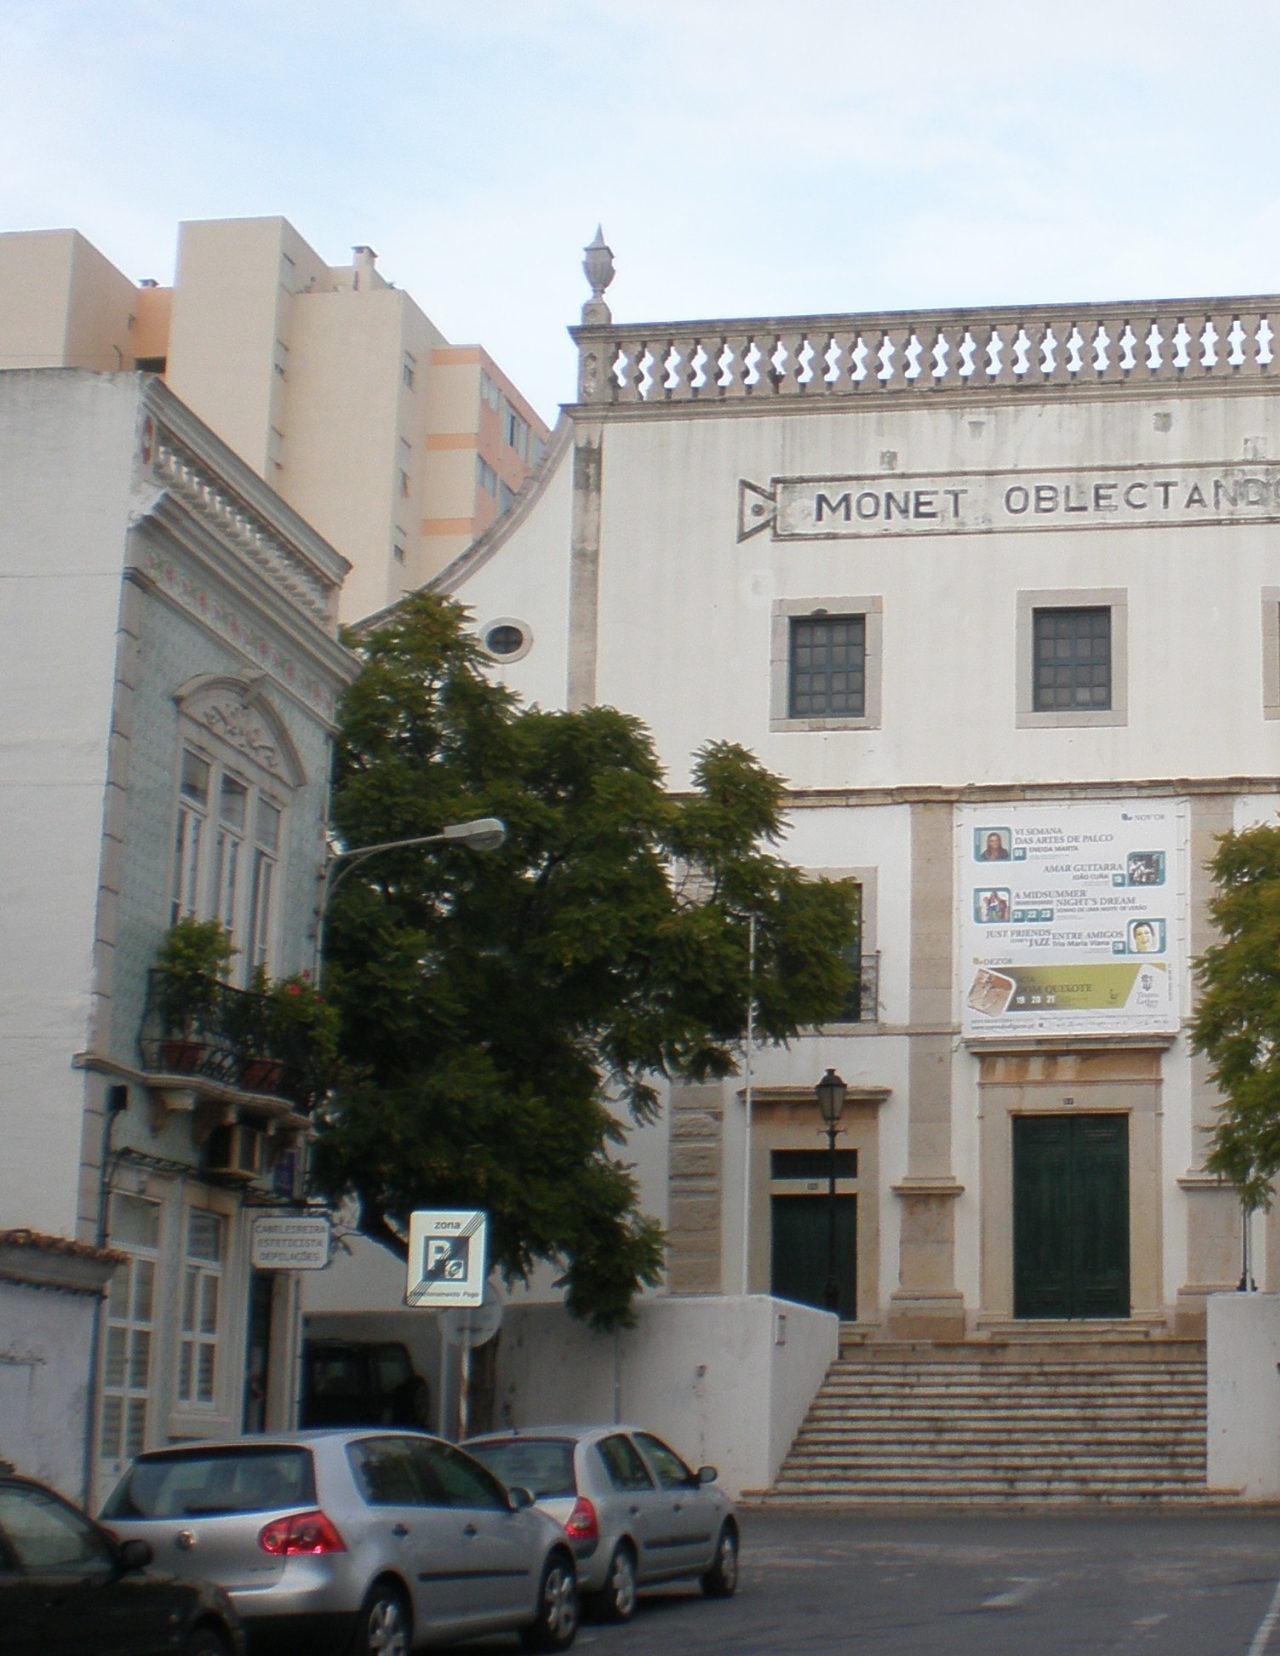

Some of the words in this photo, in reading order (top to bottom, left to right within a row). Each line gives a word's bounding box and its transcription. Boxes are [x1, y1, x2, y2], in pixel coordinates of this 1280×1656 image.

[813, 489, 968, 522] MONET
[1026, 827, 1063, 835] SEMANA
[1014, 836, 1034, 845] DAS
[1035, 835, 1065, 844] ARTES
[1067, 834, 1081, 843] DE
[1082, 833, 1114, 842] PALCO
[1043, 864, 1071, 873] AMAR
[1073, 862, 1124, 872] GUITARRA
[1014, 891, 1021, 899] A
[1023, 889, 1087, 898] MIDSUMMER
[1056, 897, 1098, 906] NIGHT'S
[1100, 896, 1136, 905] DREAM
[986, 929, 1008, 938] JUST
[1010, 928, 1051, 938] FRIENDS
[1052, 931, 1083, 940] ENTRE
[1085, 930, 1124, 939] AMIGOS
[1028, 938, 1050, 947] JAZZ
[1045, 983, 1093, 994] QUIXOTE
[434, 1220, 461, 1230] zona
